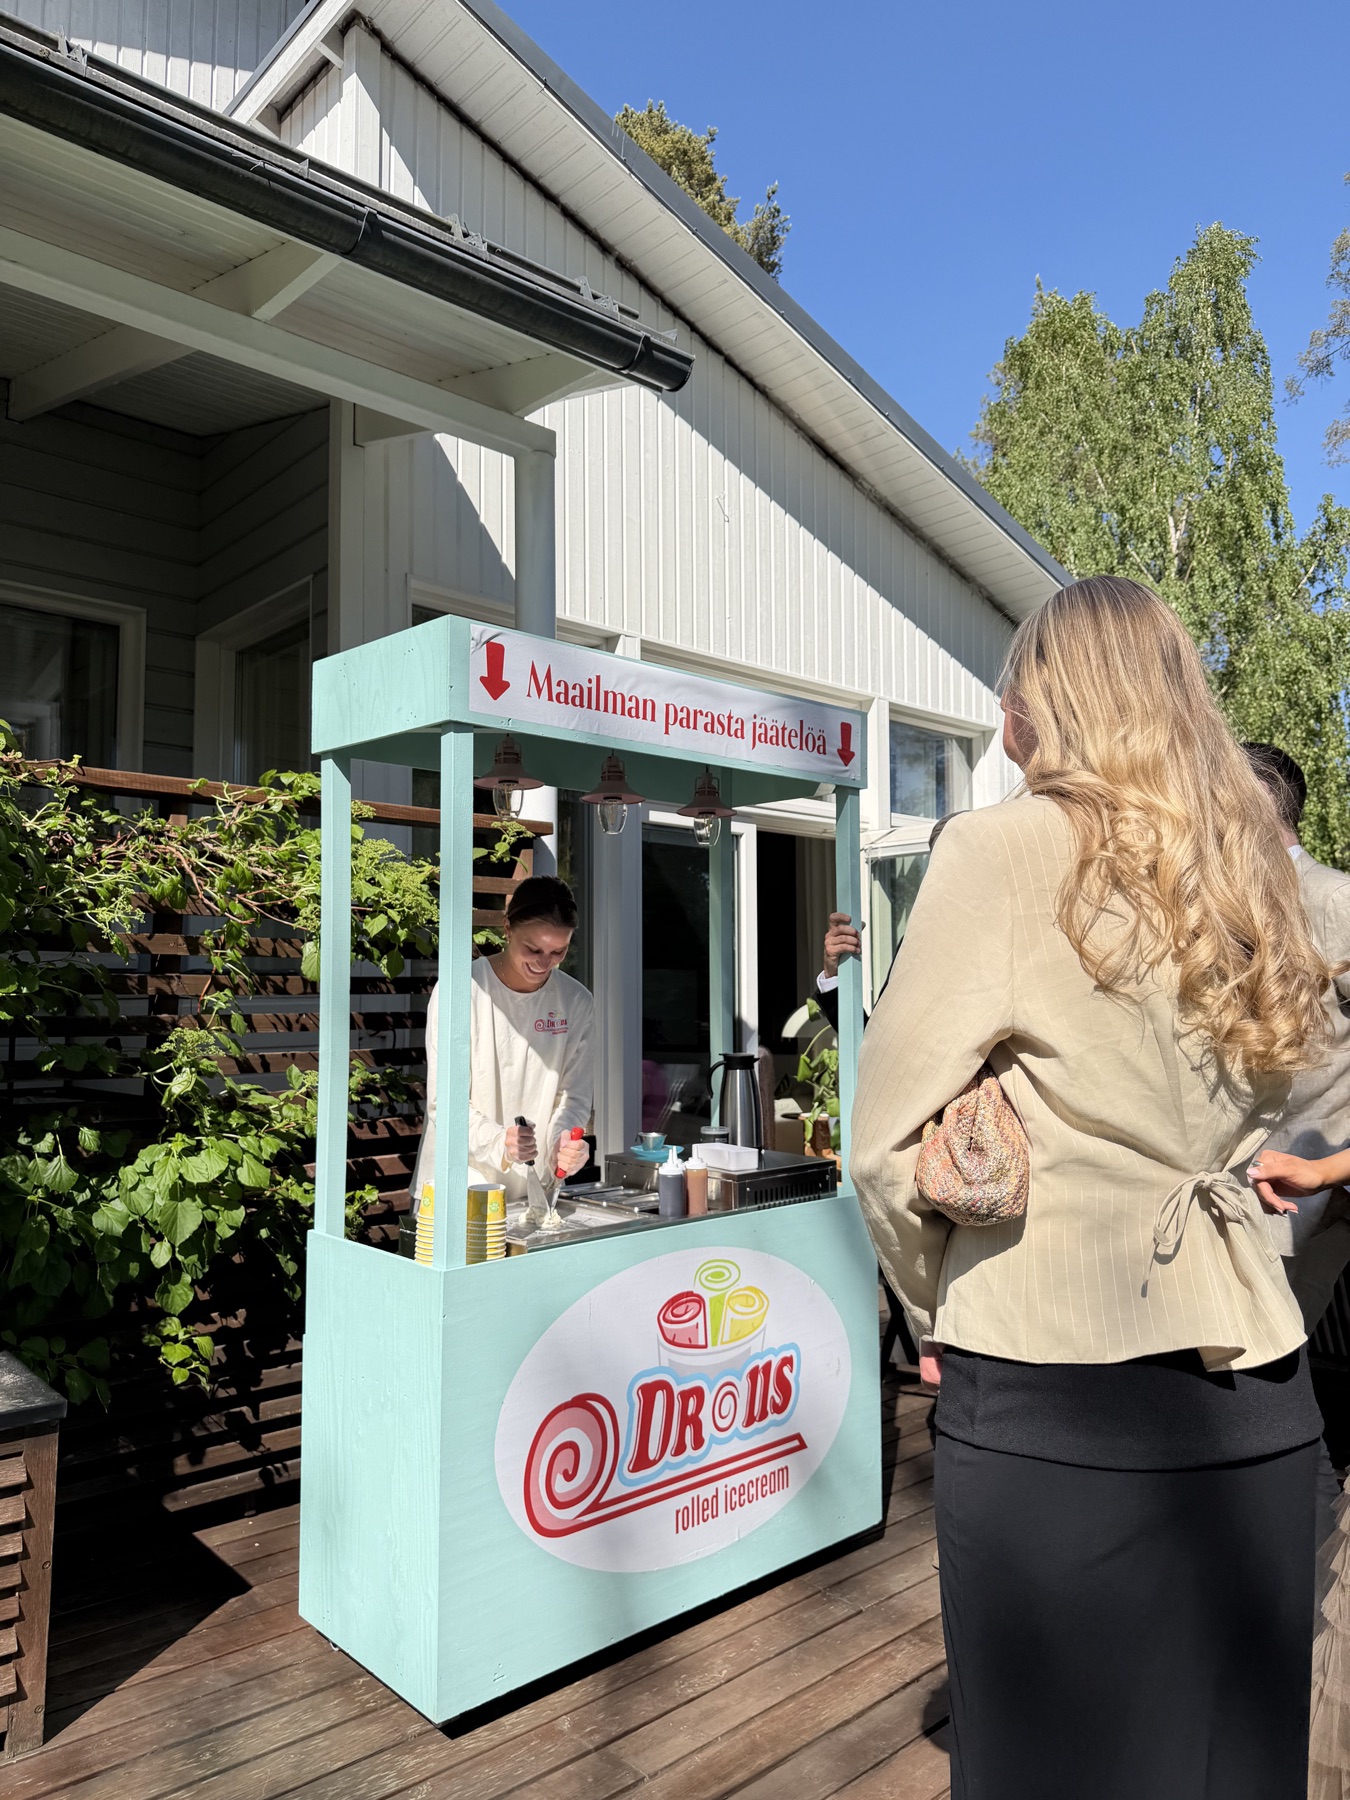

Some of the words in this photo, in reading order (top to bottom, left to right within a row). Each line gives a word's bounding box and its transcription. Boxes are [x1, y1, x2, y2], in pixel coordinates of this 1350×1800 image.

[526, 660, 656, 722] Maailman
[664, 702, 745, 740] parasta
[751, 714, 827, 755] jäätelöä
[675, 1487, 719, 1534] rolled
[724, 1465, 790, 1514] icecream
